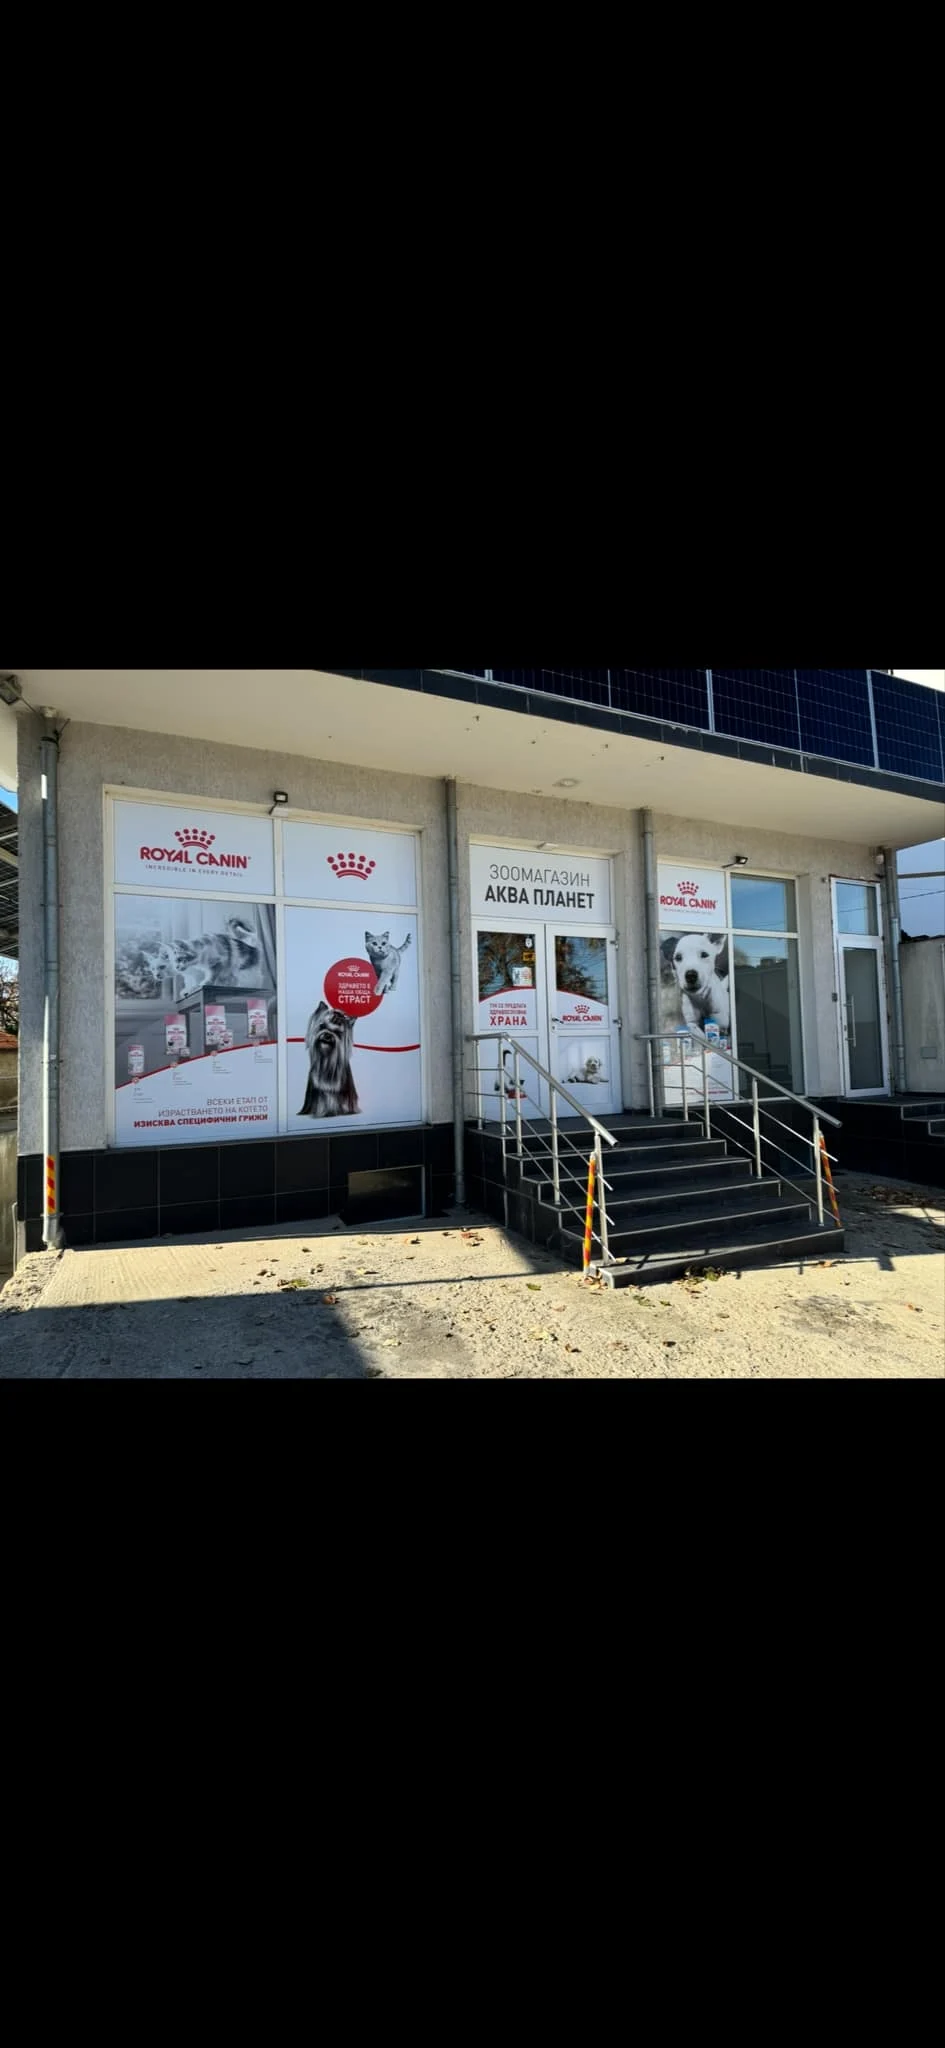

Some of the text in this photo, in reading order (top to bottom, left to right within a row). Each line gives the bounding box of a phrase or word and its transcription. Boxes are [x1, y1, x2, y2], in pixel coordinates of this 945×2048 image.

[140, 846, 248, 869] ROYAL CANIN
[489, 863, 591, 887] ЗООМАГАЗИН
[484, 884, 595, 909] АКВА ПЛАНЕТ
[660, 895, 717, 910] ROYAL CANIN
[338, 995, 371, 1004] СТРАСТ
[490, 1016, 528, 1026] ХРАНА
[207, 1096, 268, 1106] ВСЕКИ ЕТАП ОТ
[158, 1104, 268, 1118] ИЗРАСТВАНЕТО НА КОТЕТО
[133, 1113, 268, 1128] ИЗИСКВА СПЕЦИФИЧНИ ГРИЖИ
